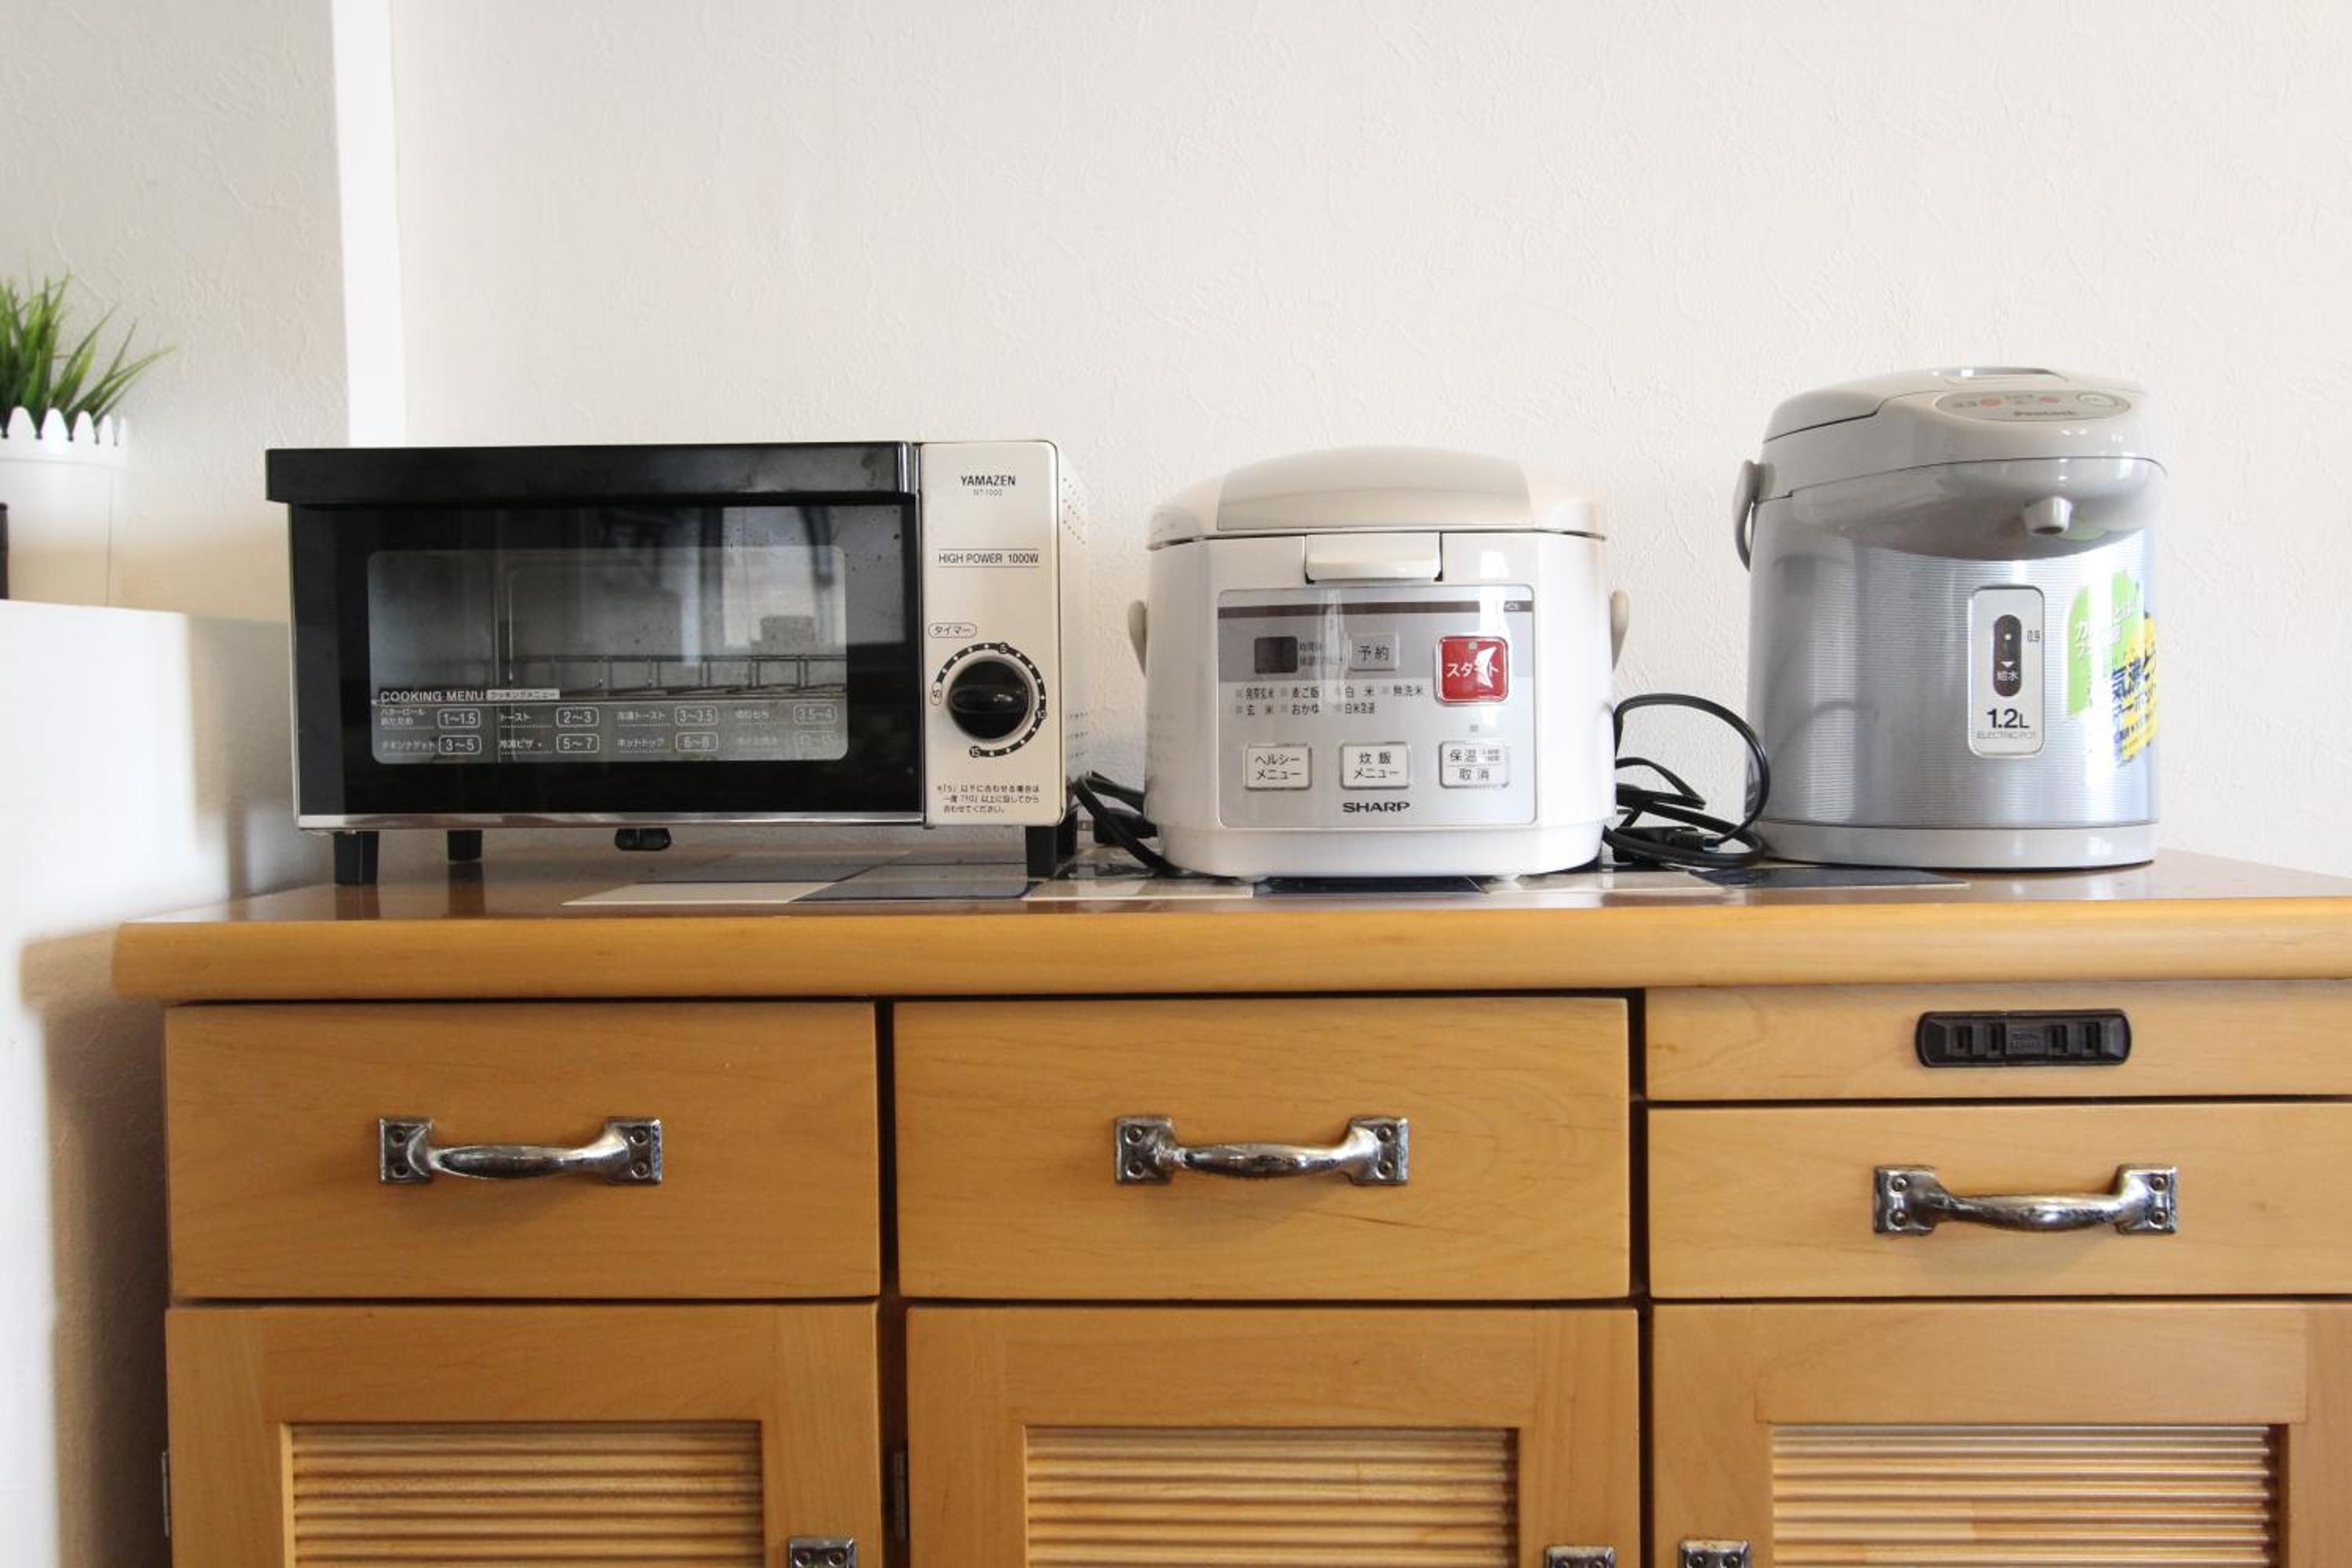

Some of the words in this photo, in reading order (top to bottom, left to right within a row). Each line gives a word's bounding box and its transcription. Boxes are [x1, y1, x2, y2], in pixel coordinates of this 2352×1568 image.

[960, 475, 1016, 486] YAMAZEN
[938, 554, 964, 564] HIGH
[966, 554, 1003, 564] POWER
[1007, 554, 1039, 564] 1000W
[935, 626, 971, 635] タイマー
[1358, 645, 1389, 662] 予約
[1446, 662, 1499, 677] スタート
[1997, 671, 2019, 682] 給水
[380, 691, 441, 702] COOKING
[445, 691, 484, 702] MENU
[1393, 685, 1423, 697] 無洗米
[500, 711, 531, 722] トースト
[1987, 709, 2030, 728] 1.2L
[1255, 753, 1301, 765] ヘルシー
[1359, 752, 1392, 765] 炊飯
[1450, 750, 1478, 762] 保温
[1256, 769, 1302, 781] メニュー
[1354, 768, 1399, 779] メニュー
[1459, 767, 1490, 781] 取消
[1342, 802, 1410, 813] SHARP
